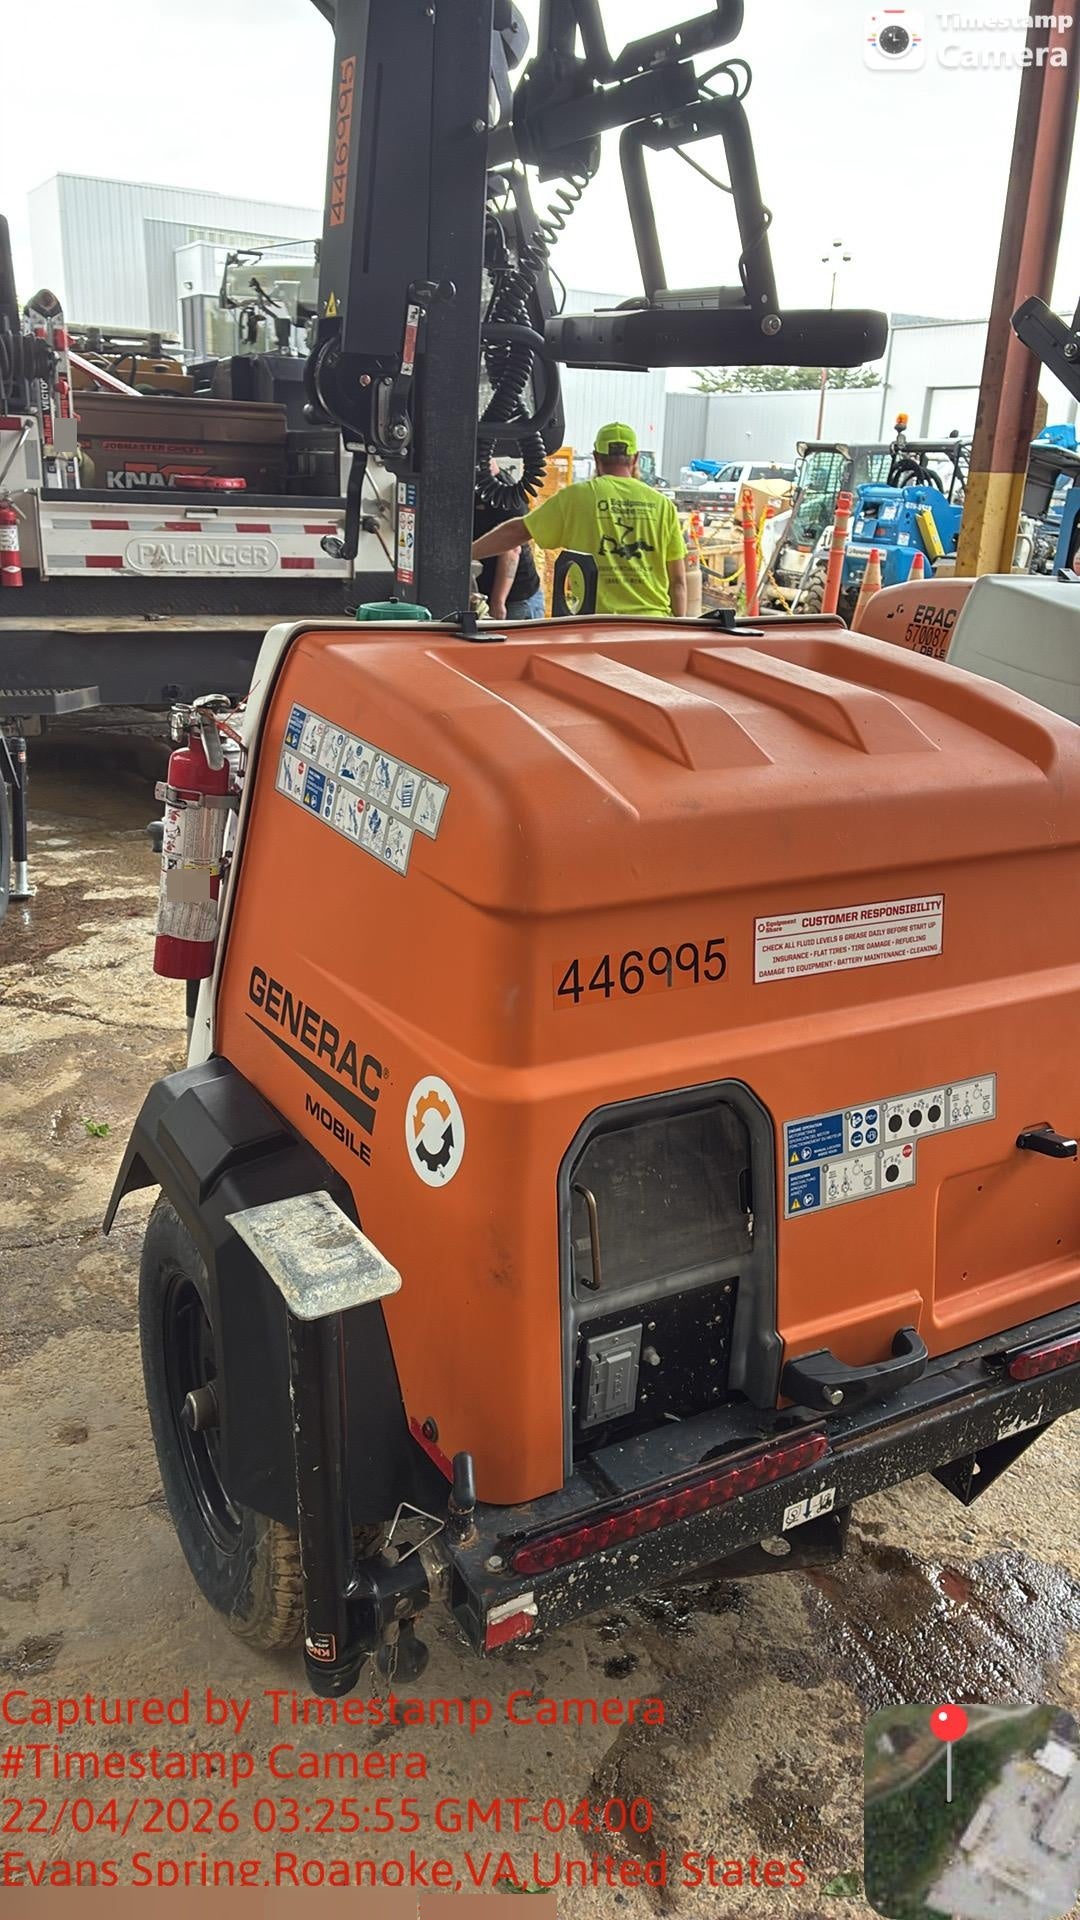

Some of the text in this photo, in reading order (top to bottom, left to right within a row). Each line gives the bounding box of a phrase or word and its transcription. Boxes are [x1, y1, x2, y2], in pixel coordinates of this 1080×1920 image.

[331, 61, 354, 221] 446995
[138, 542, 269, 567] PALFINGER
[913, 604, 957, 629] ERAC
[905, 623, 950, 649] 570087
[766, 918, 797, 928] Equipment
[801, 900, 942, 928] CUSTOMER RESPONSIBILITY
[762, 943, 784, 953] CHECK
[785, 941, 796, 950] ALL
[796, 938, 816, 948] FLUID
[816, 935, 838, 946] LEVELS
[844, 931, 868, 941] GREASE
[868, 928, 886, 938] DAILY
[886, 926, 908, 936] BEFORE
[909, 922, 927, 932] START
[927, 921, 936, 929] UP
[765, 926, 783, 934] Share
[758, 944, 938, 978] DAMAGE TO EQUIPMENT BATTERY MAINTENANCE CLEANING
[772, 934, 927, 964] INSURANCE FLAT TIRES TIRE DAMAGE REFUELING
[557, 937, 727, 1004] 446995
[249, 965, 384, 1102] GENERAC
[305, 1093, 372, 1167] MOBILE
